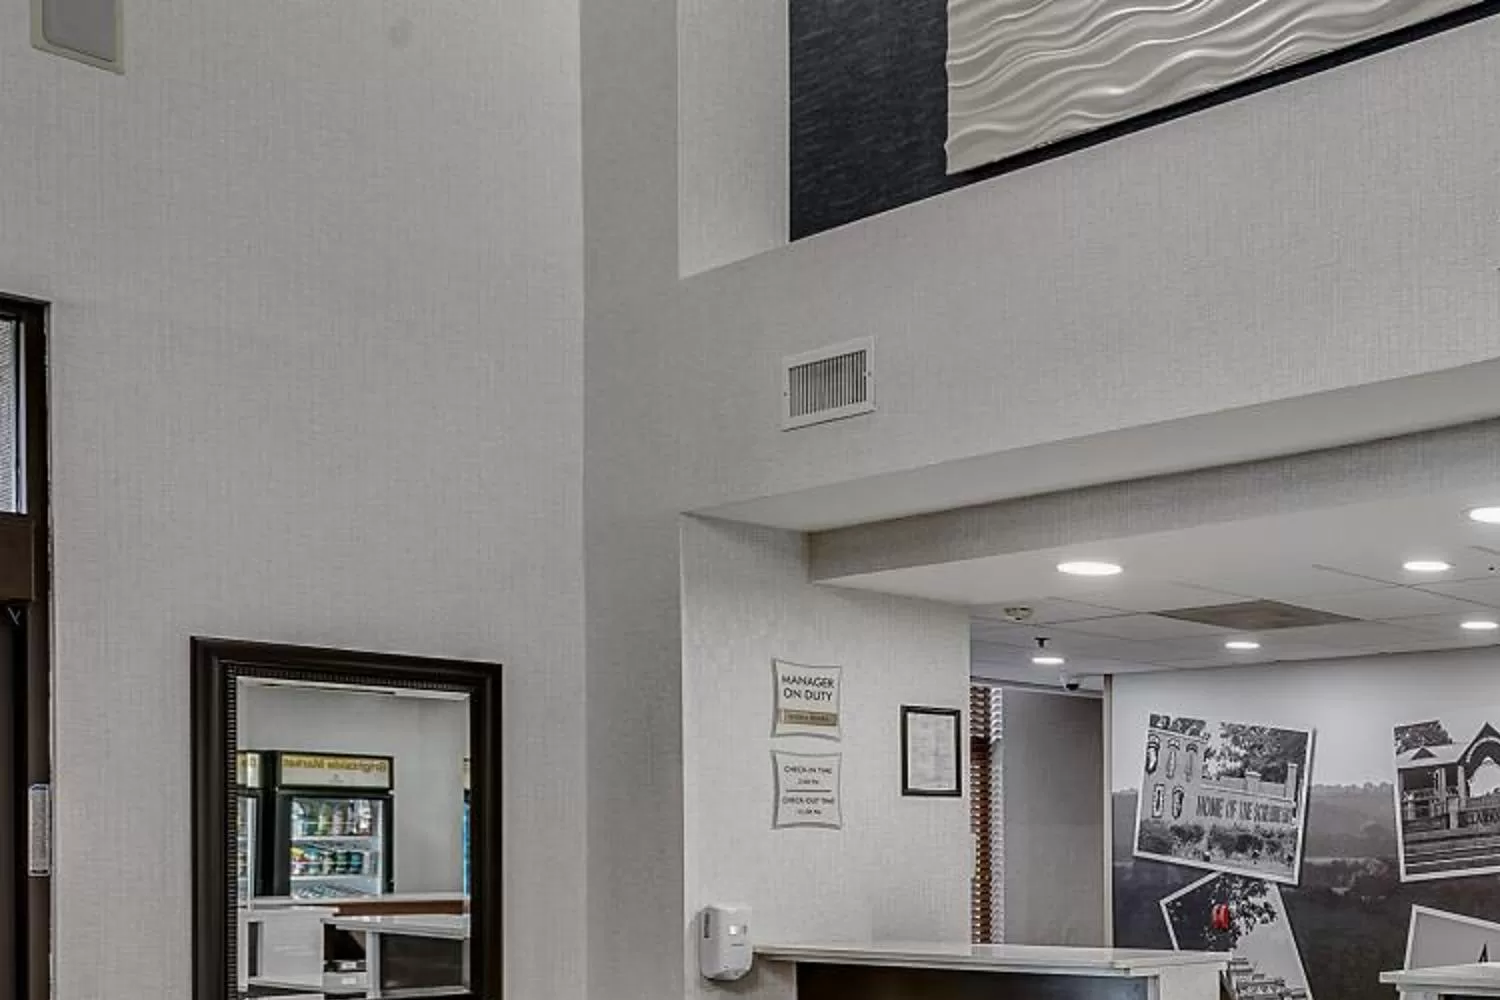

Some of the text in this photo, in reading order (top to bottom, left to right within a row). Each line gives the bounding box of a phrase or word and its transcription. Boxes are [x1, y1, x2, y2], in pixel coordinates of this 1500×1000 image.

[781, 674, 834, 689] MANAGER
[783, 687, 832, 701] ON DUTY
